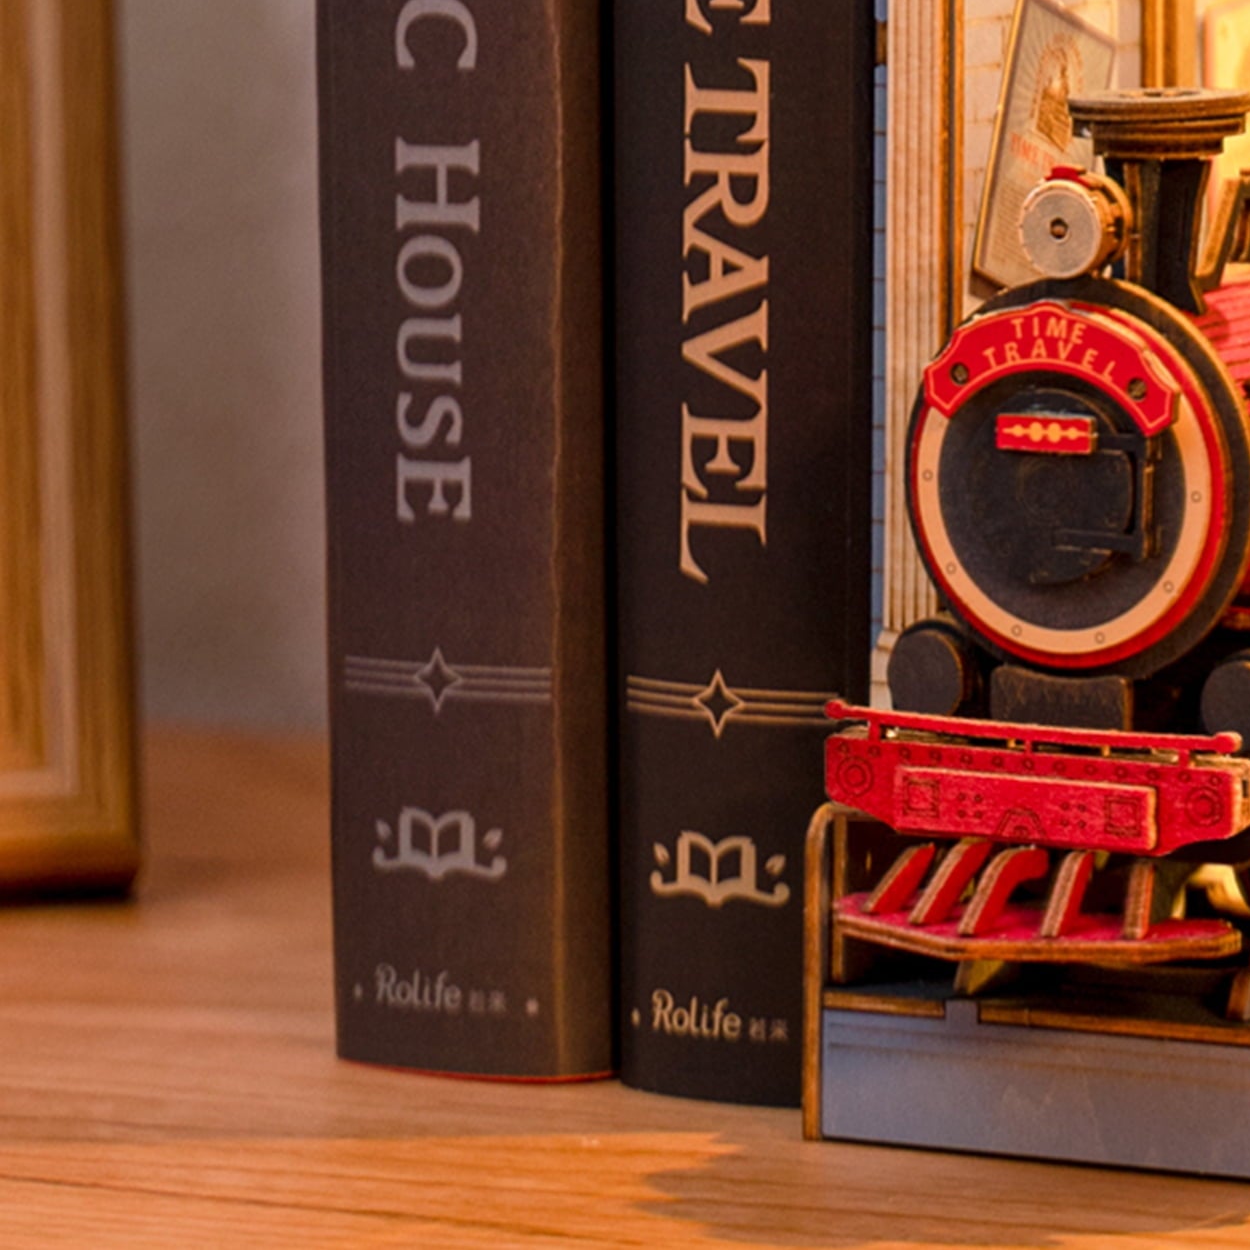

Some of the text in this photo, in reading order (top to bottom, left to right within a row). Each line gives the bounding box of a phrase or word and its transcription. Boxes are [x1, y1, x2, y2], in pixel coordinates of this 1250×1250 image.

[395, 137, 481, 522] HOUSE
[680, 57, 771, 583] TRAVEL
[1011, 317, 1087, 344] TIME
[983, 338, 1119, 383] TRAVEL
[375, 963, 462, 1011] Rolife
[652, 988, 742, 1039] Rolife
